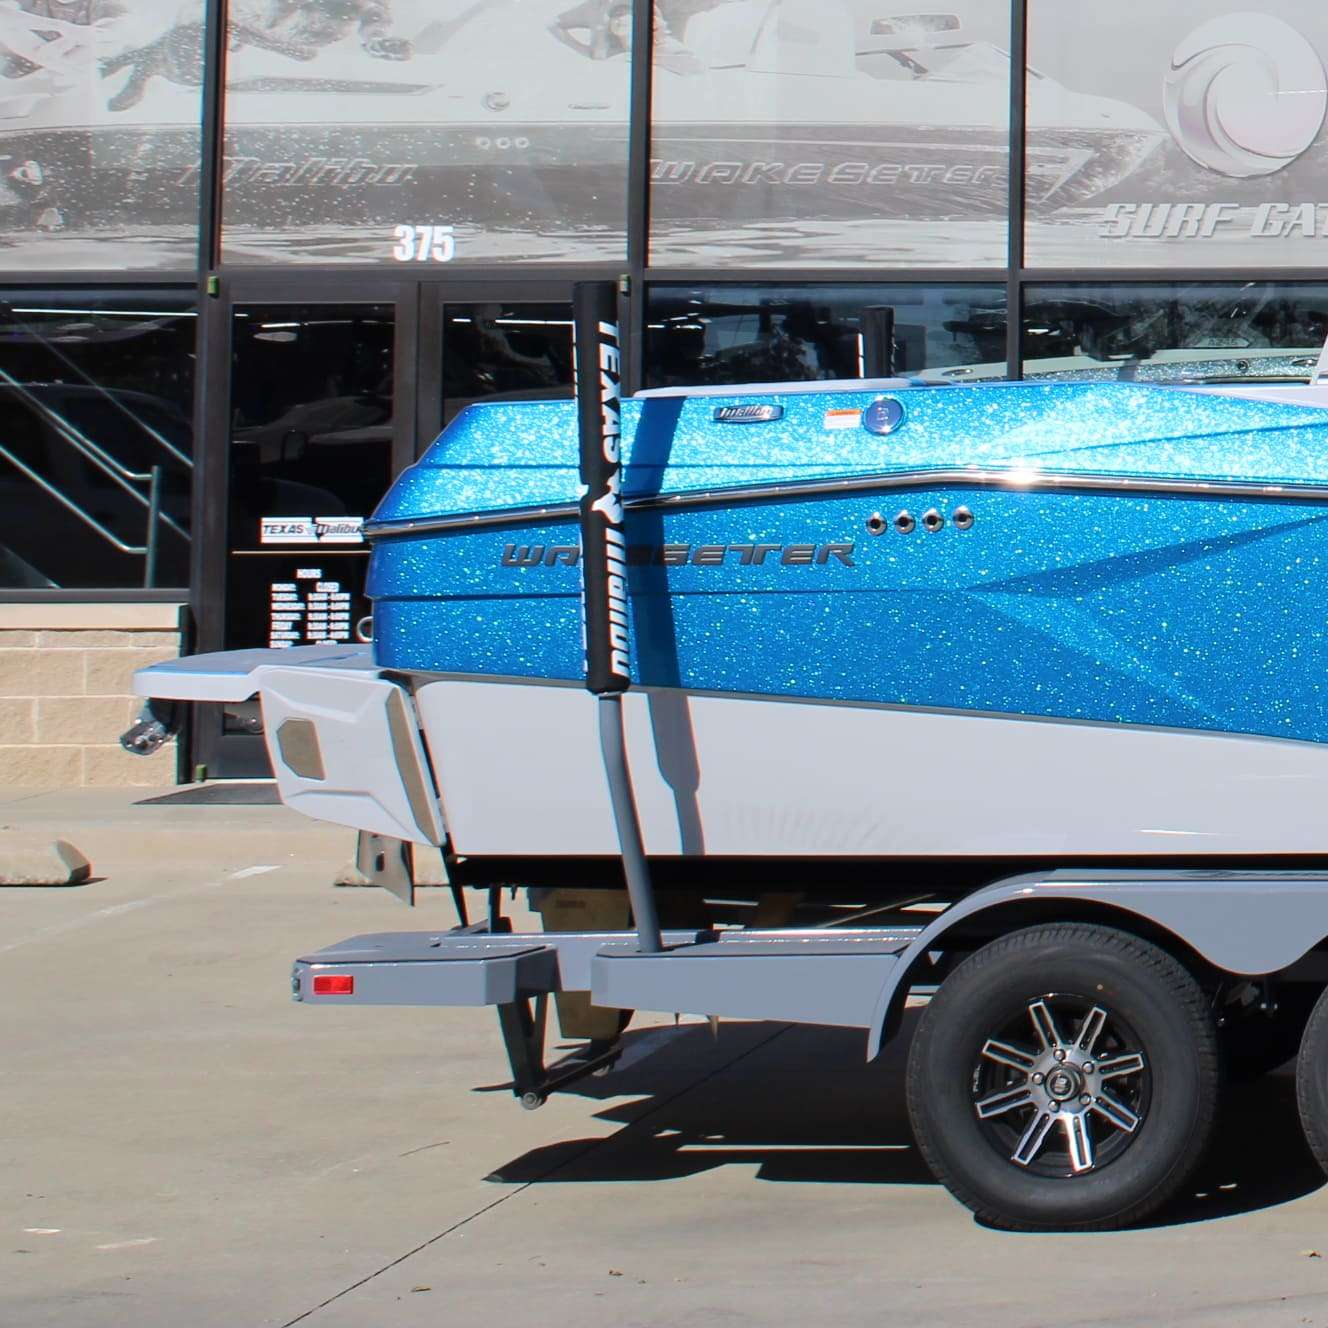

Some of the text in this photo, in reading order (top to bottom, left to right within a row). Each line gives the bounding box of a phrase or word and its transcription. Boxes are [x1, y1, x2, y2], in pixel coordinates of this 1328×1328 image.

[1099, 202, 1239, 238] SURF
[393, 224, 455, 262] 375
[263, 524, 304, 534] TEXAS
[501, 542, 856, 568] WASETTER
